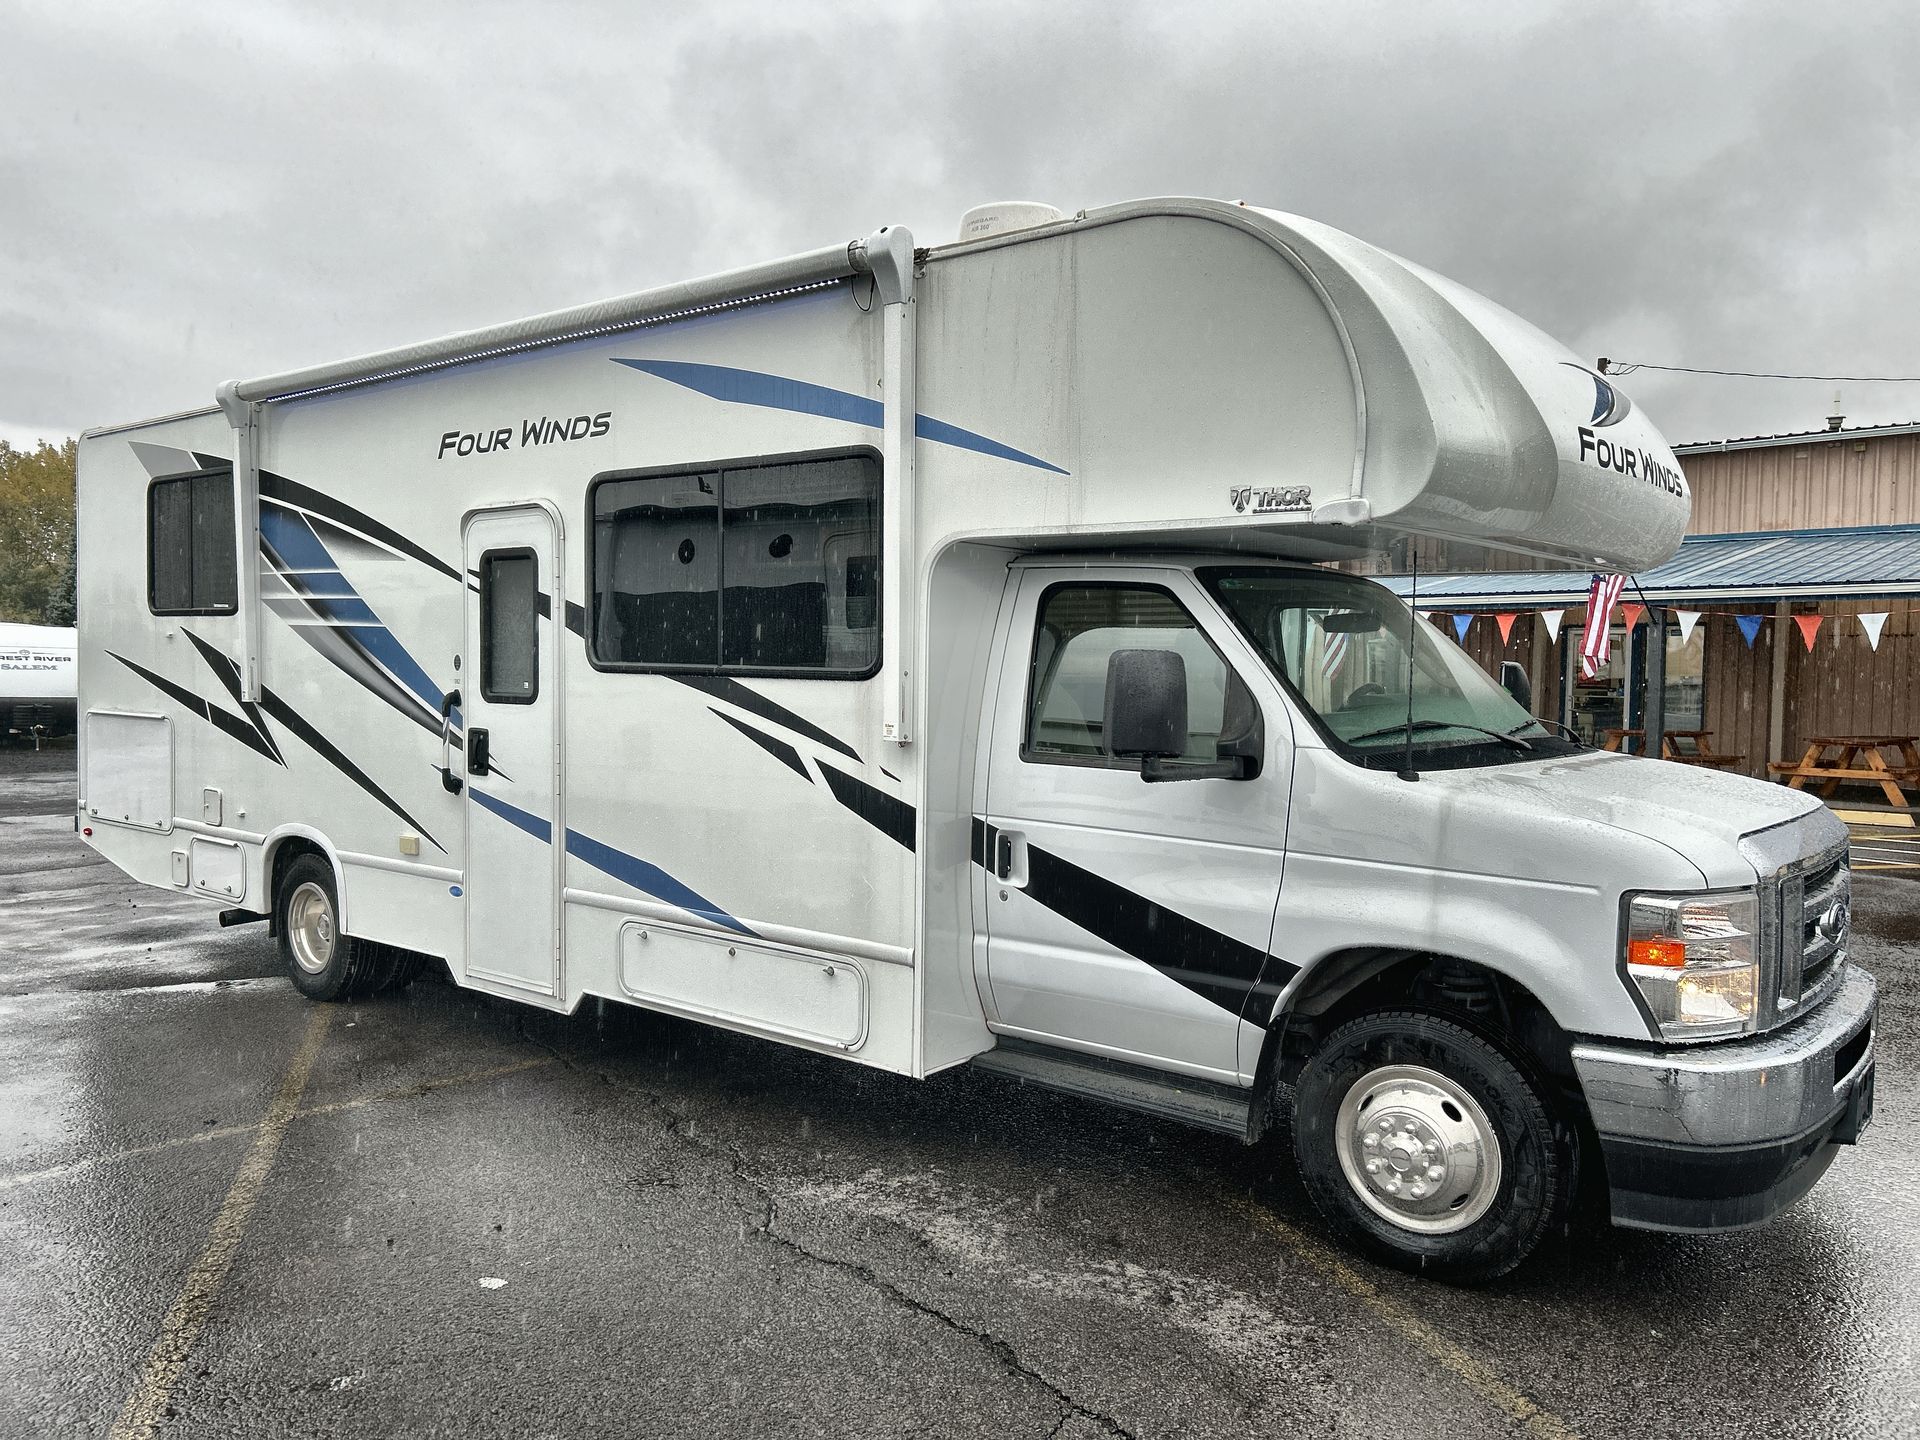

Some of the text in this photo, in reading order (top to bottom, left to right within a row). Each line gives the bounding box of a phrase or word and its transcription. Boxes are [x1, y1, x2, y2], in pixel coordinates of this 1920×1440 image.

[437, 411, 612, 460] FOUR WINDS
[1577, 425, 1684, 498] FOUR WINDS
[1253, 486, 1312, 507] THOR
